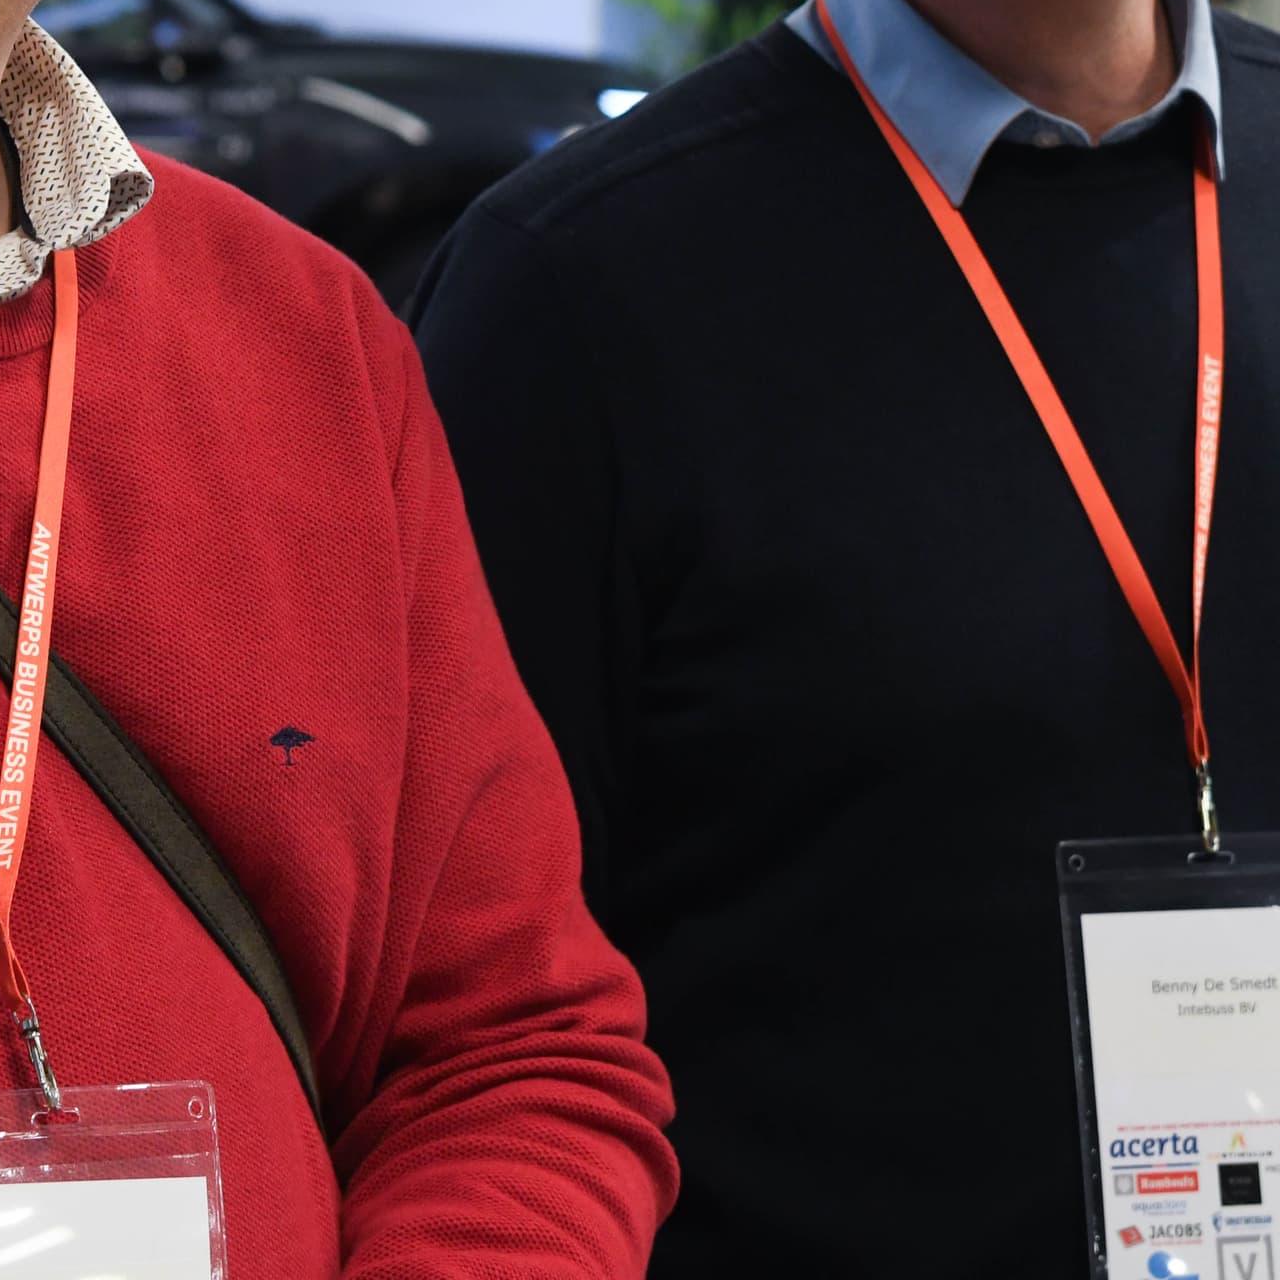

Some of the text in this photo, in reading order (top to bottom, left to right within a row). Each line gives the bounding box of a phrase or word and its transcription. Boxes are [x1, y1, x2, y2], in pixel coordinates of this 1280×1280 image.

[1202, 353, 1219, 423] EVENT
[1197, 424, 1217, 531] BUSINESS
[20, 521, 52, 657] ANTWERPS
[3, 663, 38, 783] BUSINESS
[1151, 975, 1279, 997] Benny De Smedt
[1109, 1133, 1199, 1158] acerta
[1149, 1223, 1202, 1239] JACOBS
